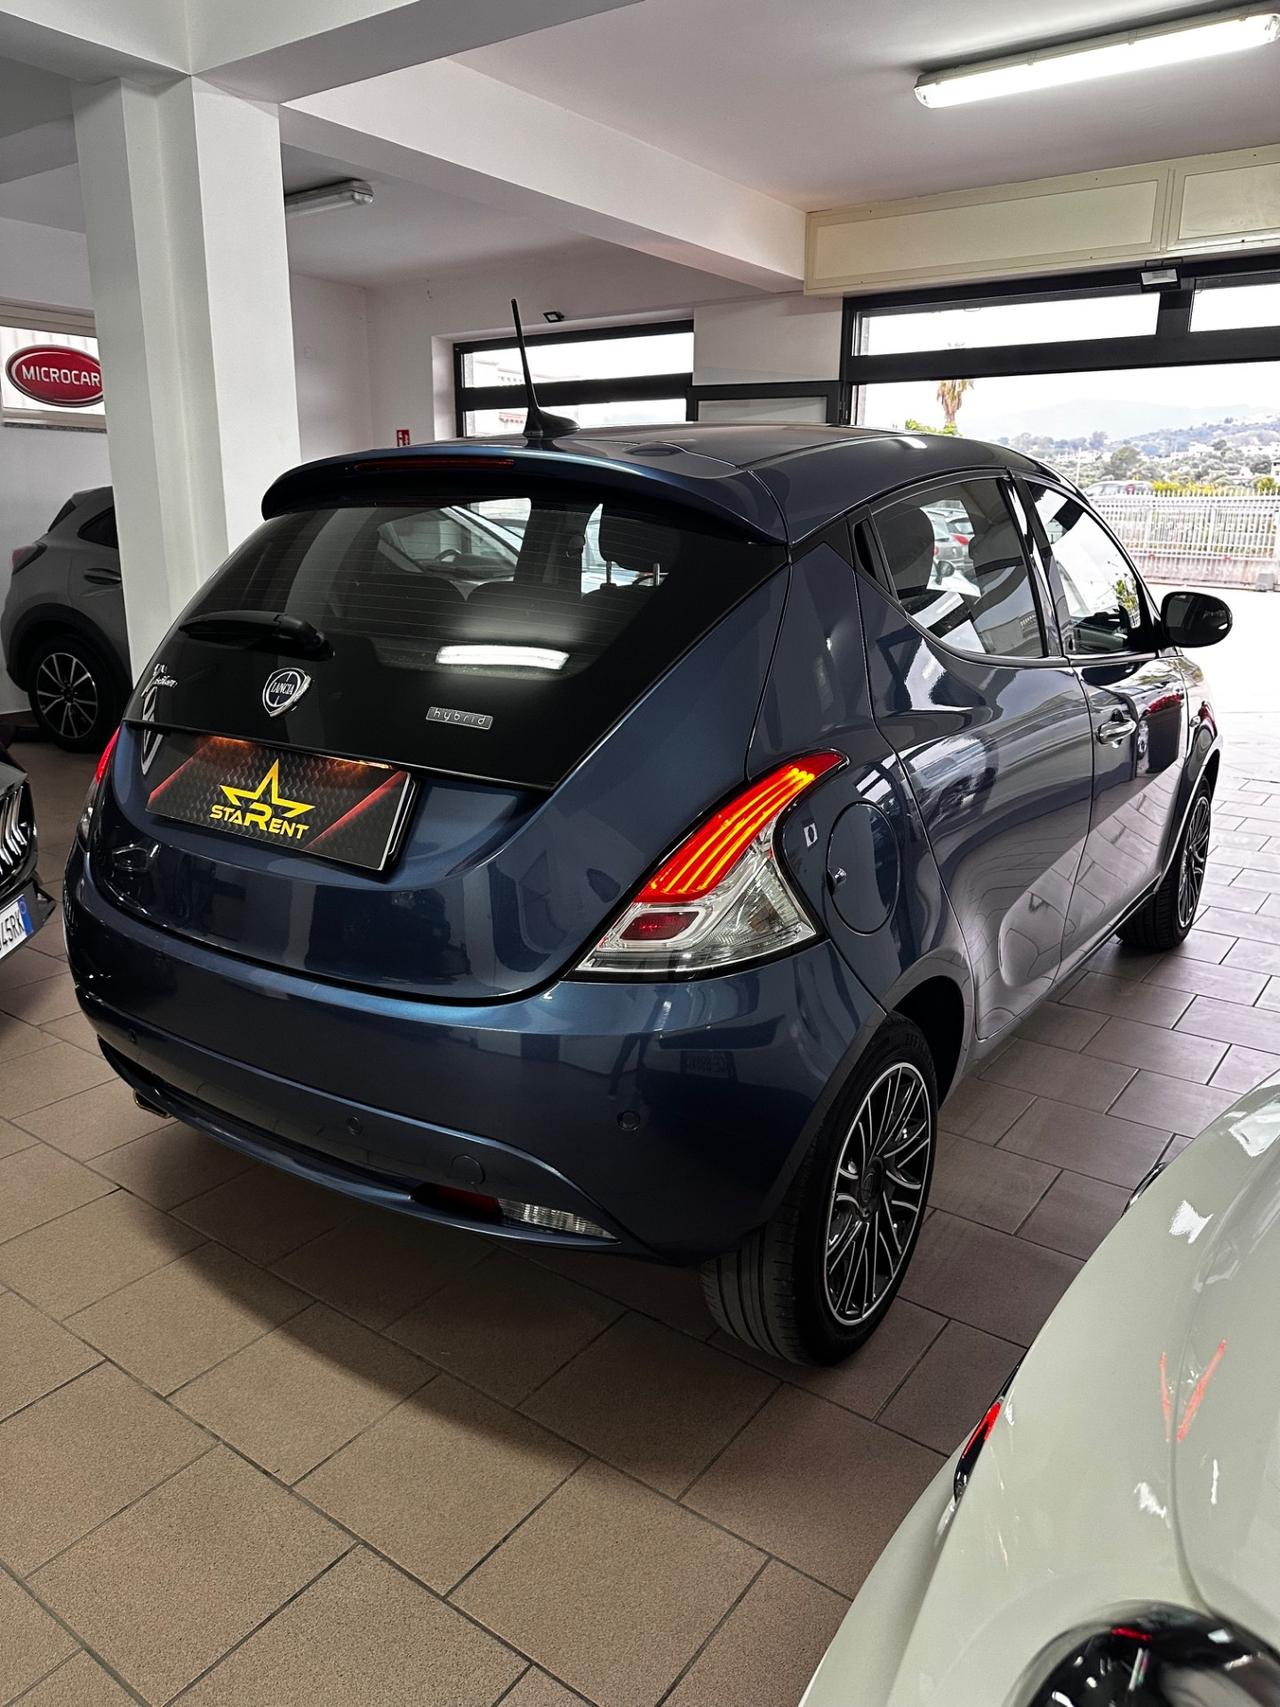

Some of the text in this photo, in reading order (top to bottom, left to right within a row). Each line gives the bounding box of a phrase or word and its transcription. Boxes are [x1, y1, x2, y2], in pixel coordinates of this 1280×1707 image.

[21, 364, 101, 387] MICROCAR
[433, 708, 486, 725] hybrid
[0, 910, 25, 951] 45RK
